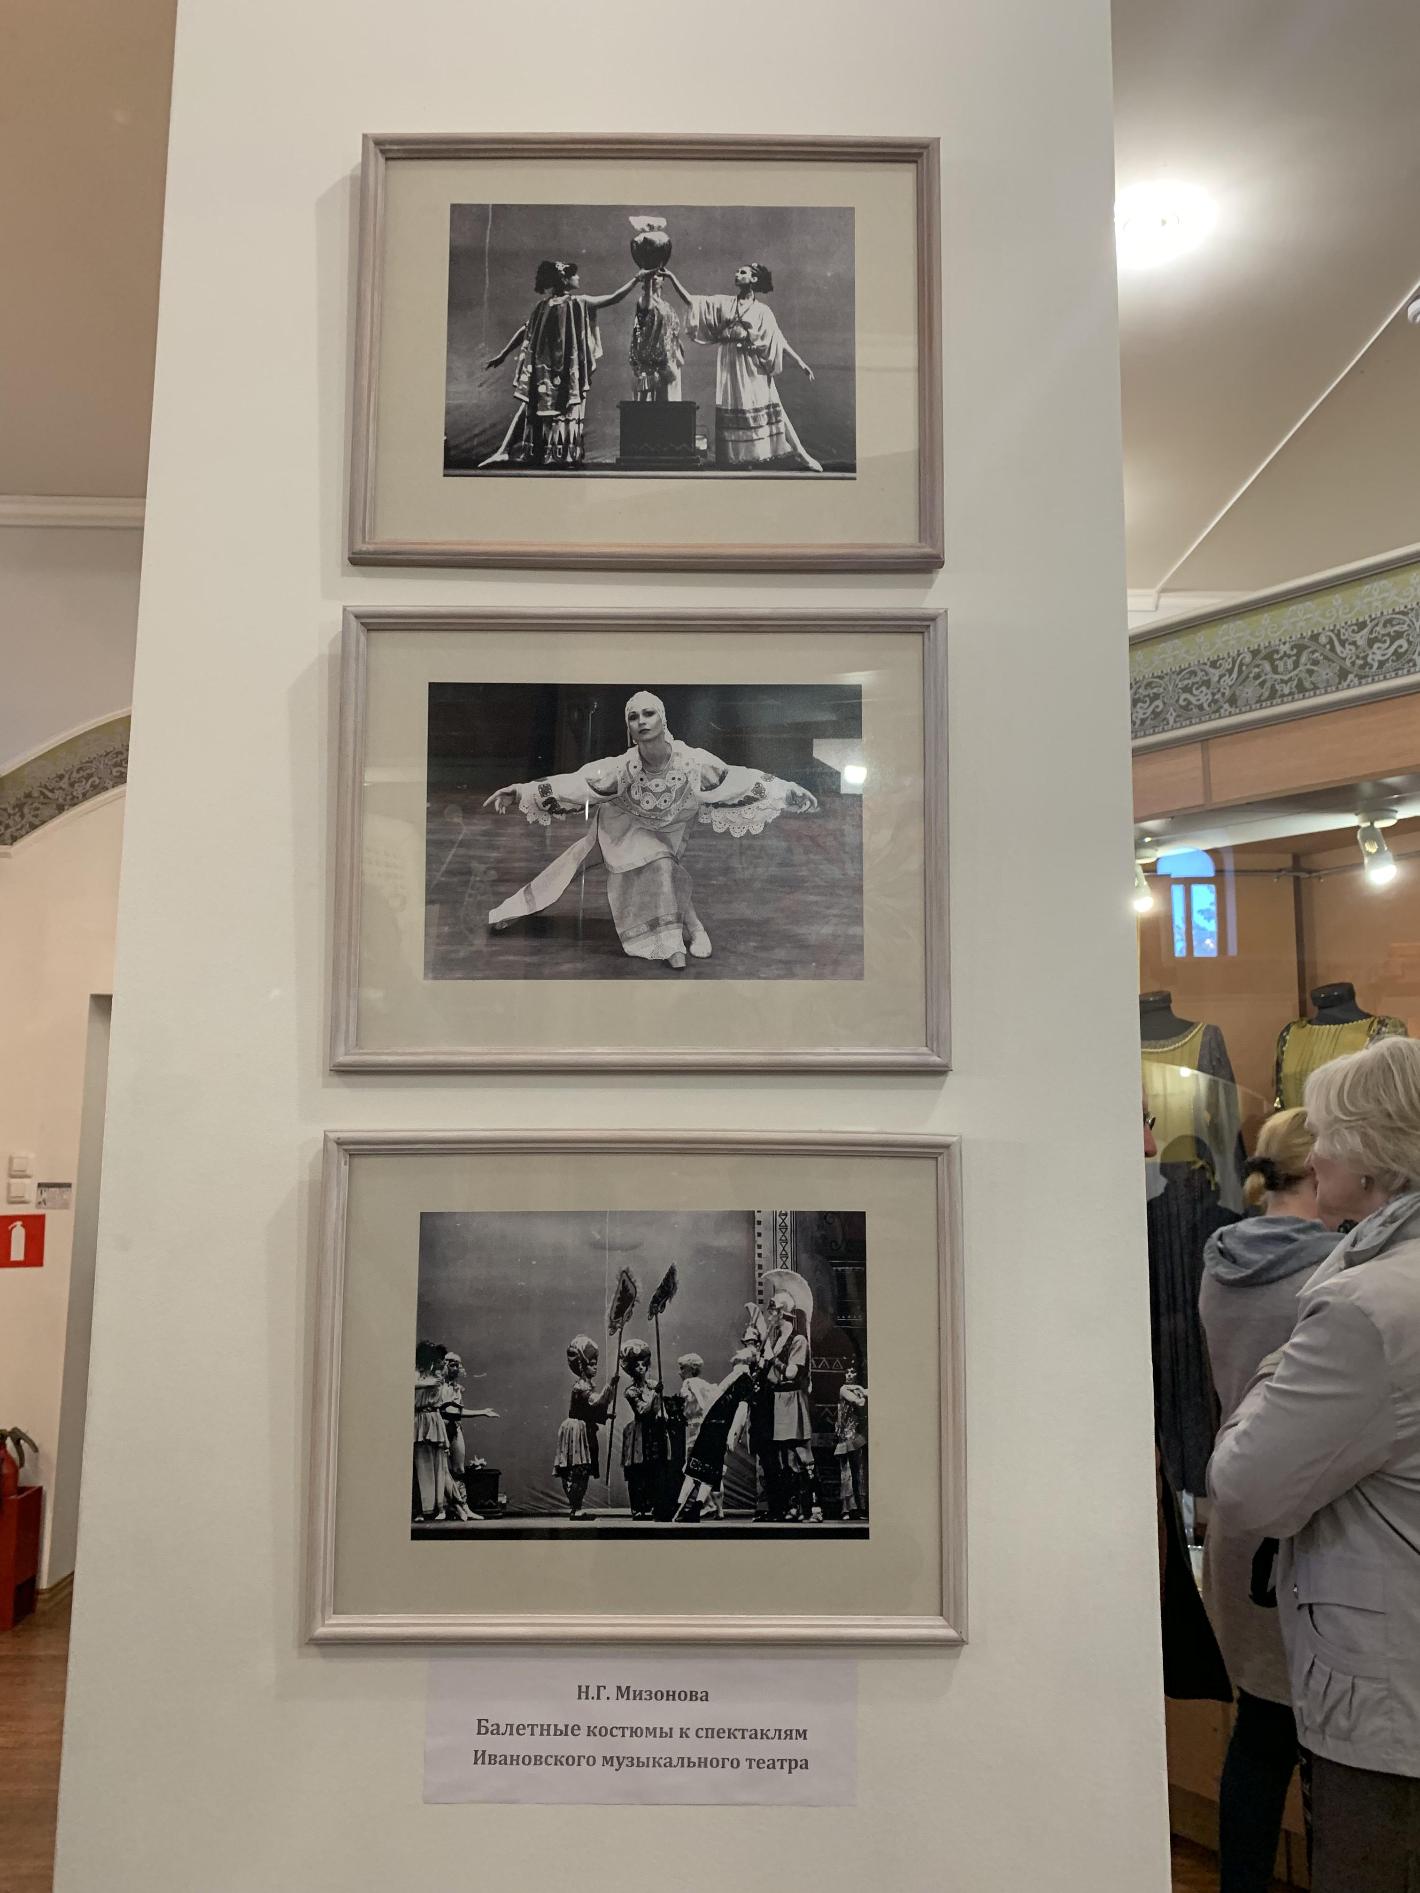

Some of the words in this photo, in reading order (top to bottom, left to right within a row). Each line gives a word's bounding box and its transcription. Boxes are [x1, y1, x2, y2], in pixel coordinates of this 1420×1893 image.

[577, 1684, 611, 1702] Н.Г.
[615, 1685, 710, 1702] Мизонова
[476, 1718, 582, 1737] Балетные
[586, 1725, 674, 1740] костюмы
[678, 1727, 691, 1740] к
[695, 1727, 808, 1745] спектаклям
[473, 1749, 597, 1767] Ивановского
[601, 1755, 741, 1773] музыкального
[745, 1757, 809, 1775] театра
